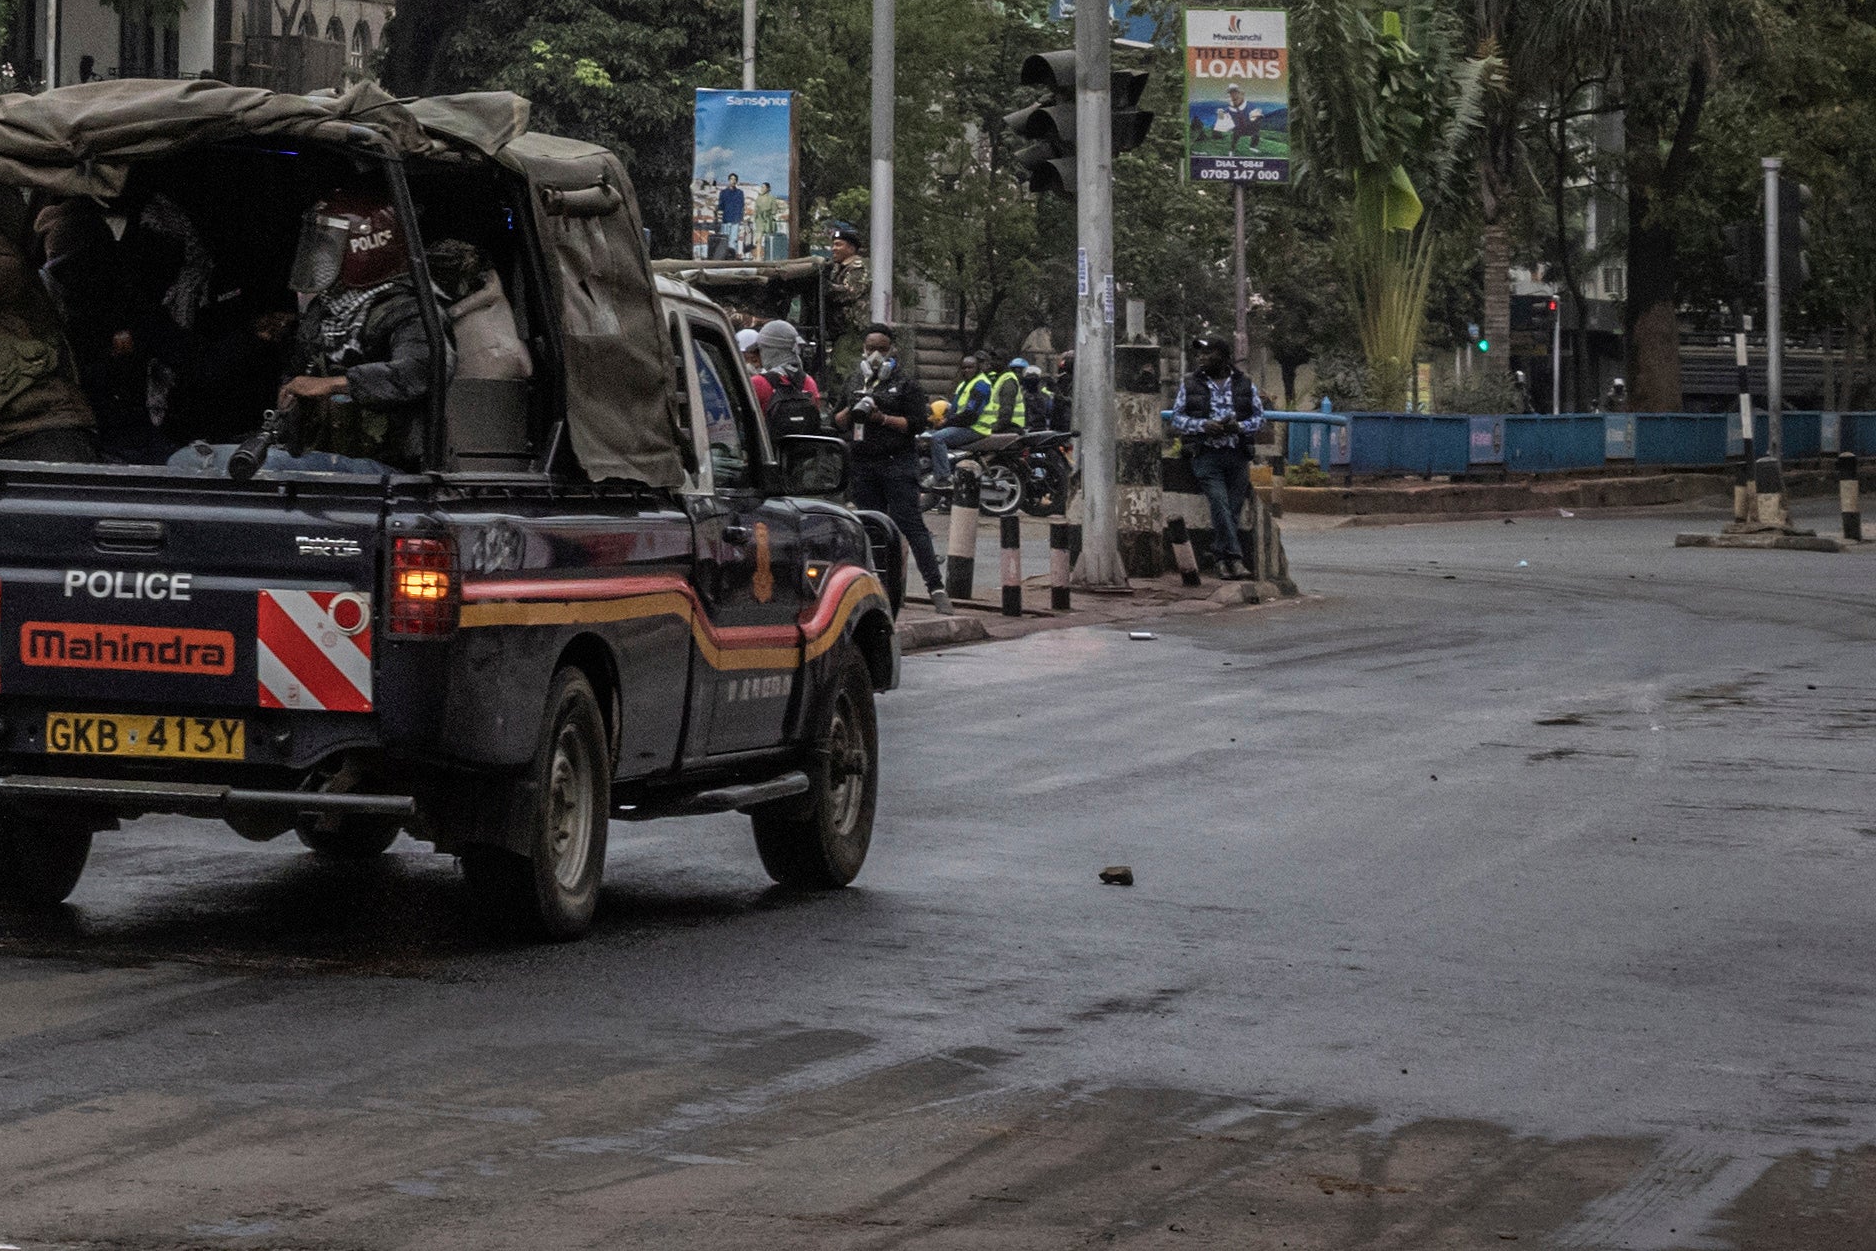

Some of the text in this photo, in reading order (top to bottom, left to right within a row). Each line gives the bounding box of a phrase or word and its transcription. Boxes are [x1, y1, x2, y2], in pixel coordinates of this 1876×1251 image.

[1212, 33, 1262, 41] Mwananchi
[1196, 48, 1279, 60] TITLE DEED
[1195, 58, 1281, 79] LOANS
[726, 96, 789, 107] Samsonite
[1200, 169, 1280, 180] 0709 147 000
[64, 570, 192, 601] POLICE
[29, 629, 225, 666] Mahindra
[50, 717, 239, 754] GKB 413Y
